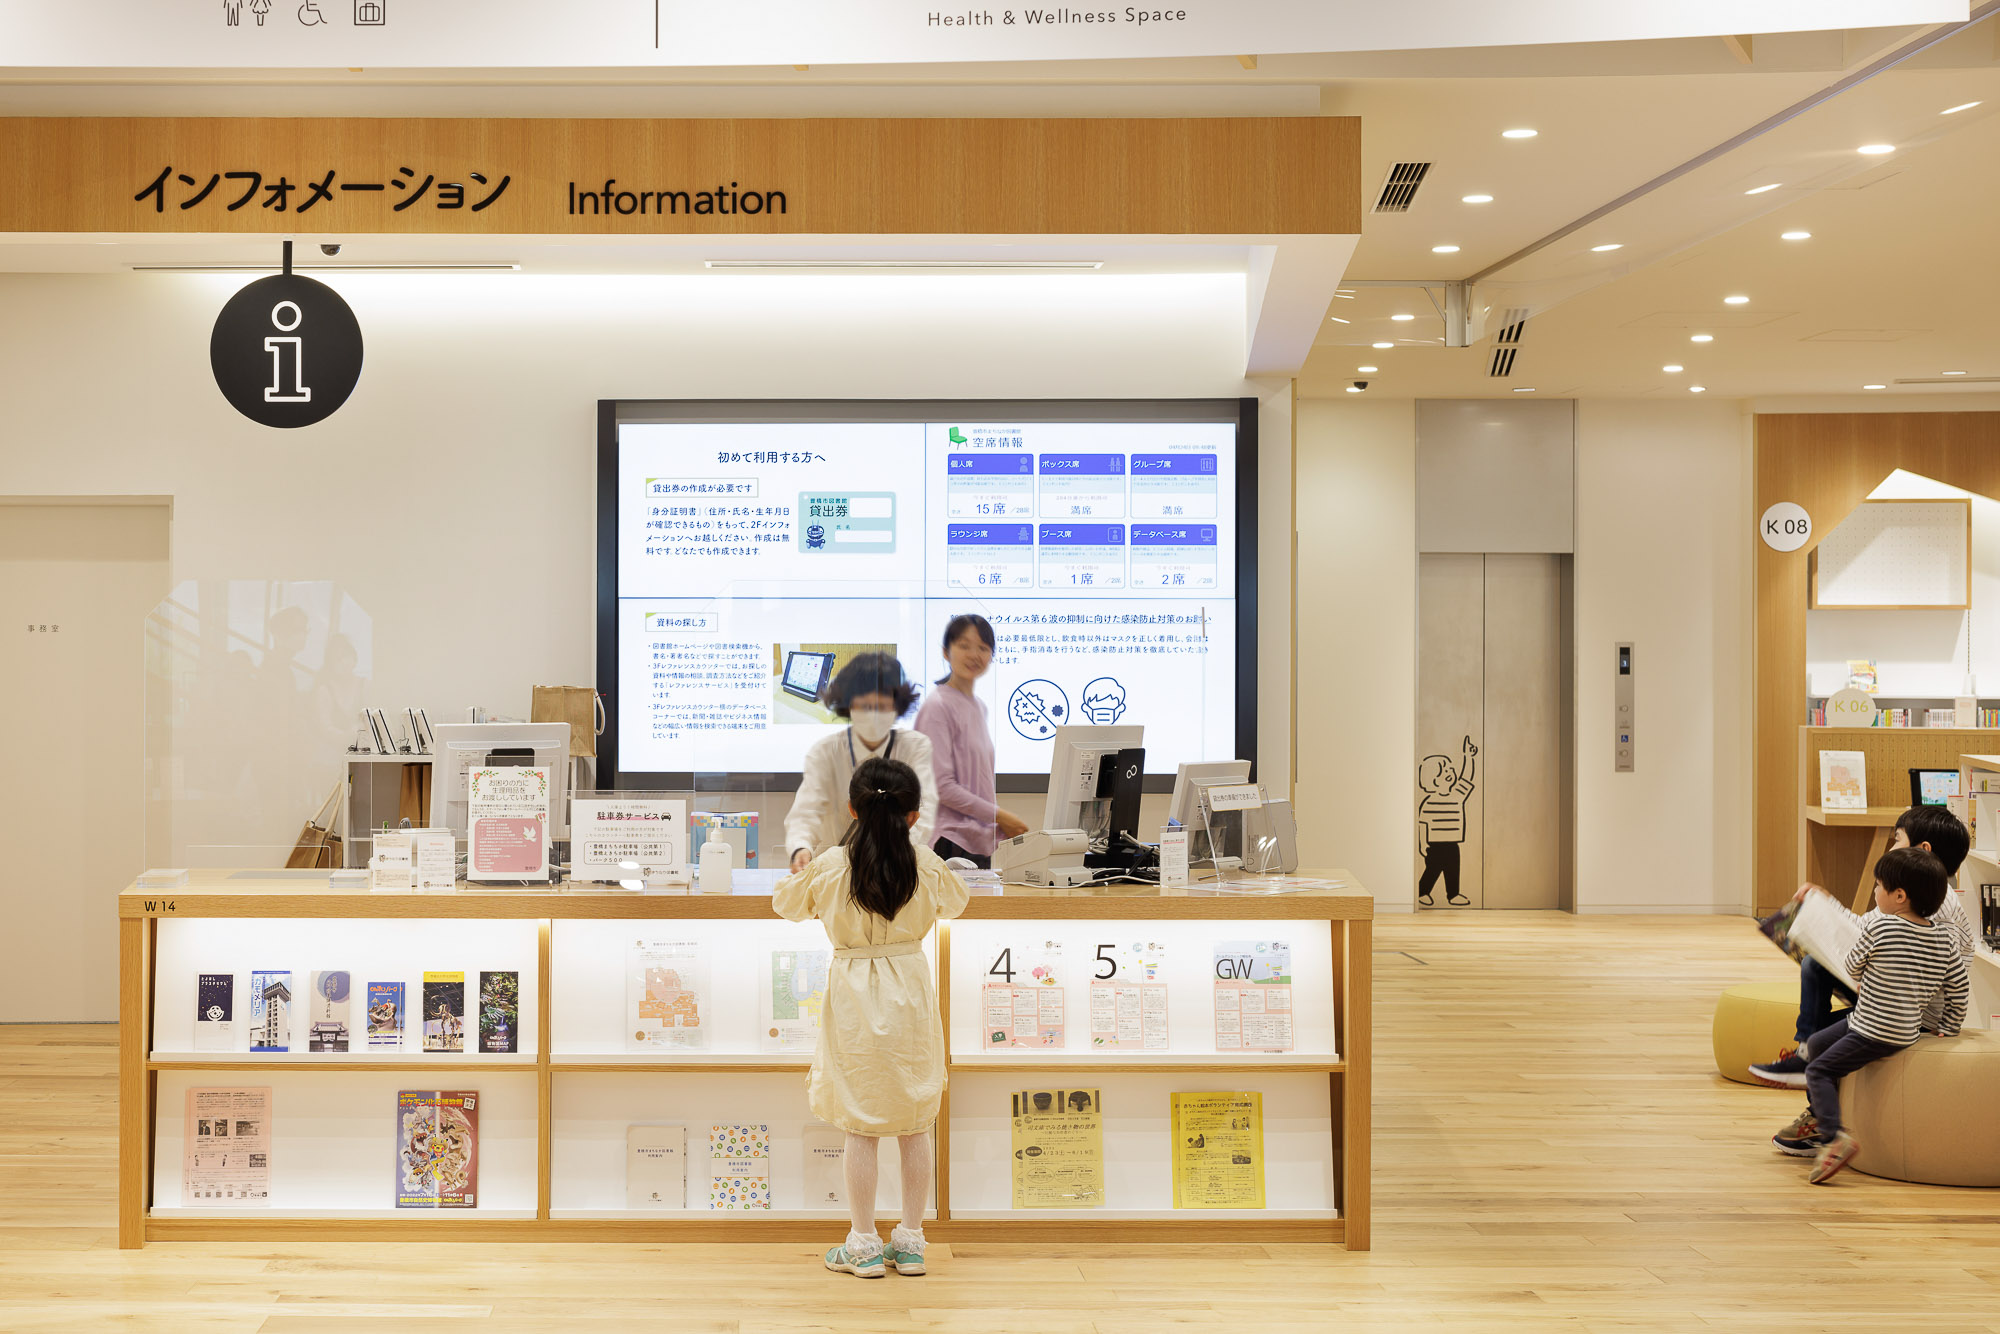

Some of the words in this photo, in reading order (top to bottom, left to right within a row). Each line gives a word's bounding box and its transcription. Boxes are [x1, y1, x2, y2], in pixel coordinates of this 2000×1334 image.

[927, 10, 994, 26] Health
[1002, 9, 1017, 25] &
[1025, 7, 1117, 25] Wellness
[1125, 6, 1187, 25] Space
[134, 166, 511, 213] インフォメーション
[568, 180, 788, 215] Information
[972, 437, 1023, 448] 空席情報
[717, 451, 826, 464] 初めて利用する方へ
[950, 460, 973, 468] 個人席
[653, 484, 753, 493] 貸出券の作成が必要です
[809, 504, 848, 517] 貸出券
[1070, 505, 1092, 515] 満席
[1162, 505, 1184, 515] 満席
[1766, 520, 1778, 534] K
[1784, 519, 1807, 535] 08
[950, 530, 989, 538] ラウンジ席
[1133, 530, 1187, 538] データベース席
[656, 618, 707, 627] 資料の探し方
[951, 614, 1212, 624] ナウイルス第6波の抑制に向けた感染防止対策のお願い
[27, 624, 60, 633] 事務室
[1835, 701, 1845, 712] K
[1850, 700, 1868, 712] 06
[597, 812, 659, 820] 駐車券サービス
[145, 901, 157, 912] W
[161, 901, 176, 912] 14
[989, 948, 1016, 983] 4
[1095, 944, 1117, 980] 5
[1216, 958, 1253, 980] GW
[400, 1098, 463, 1107] ポケモン化石博物館
